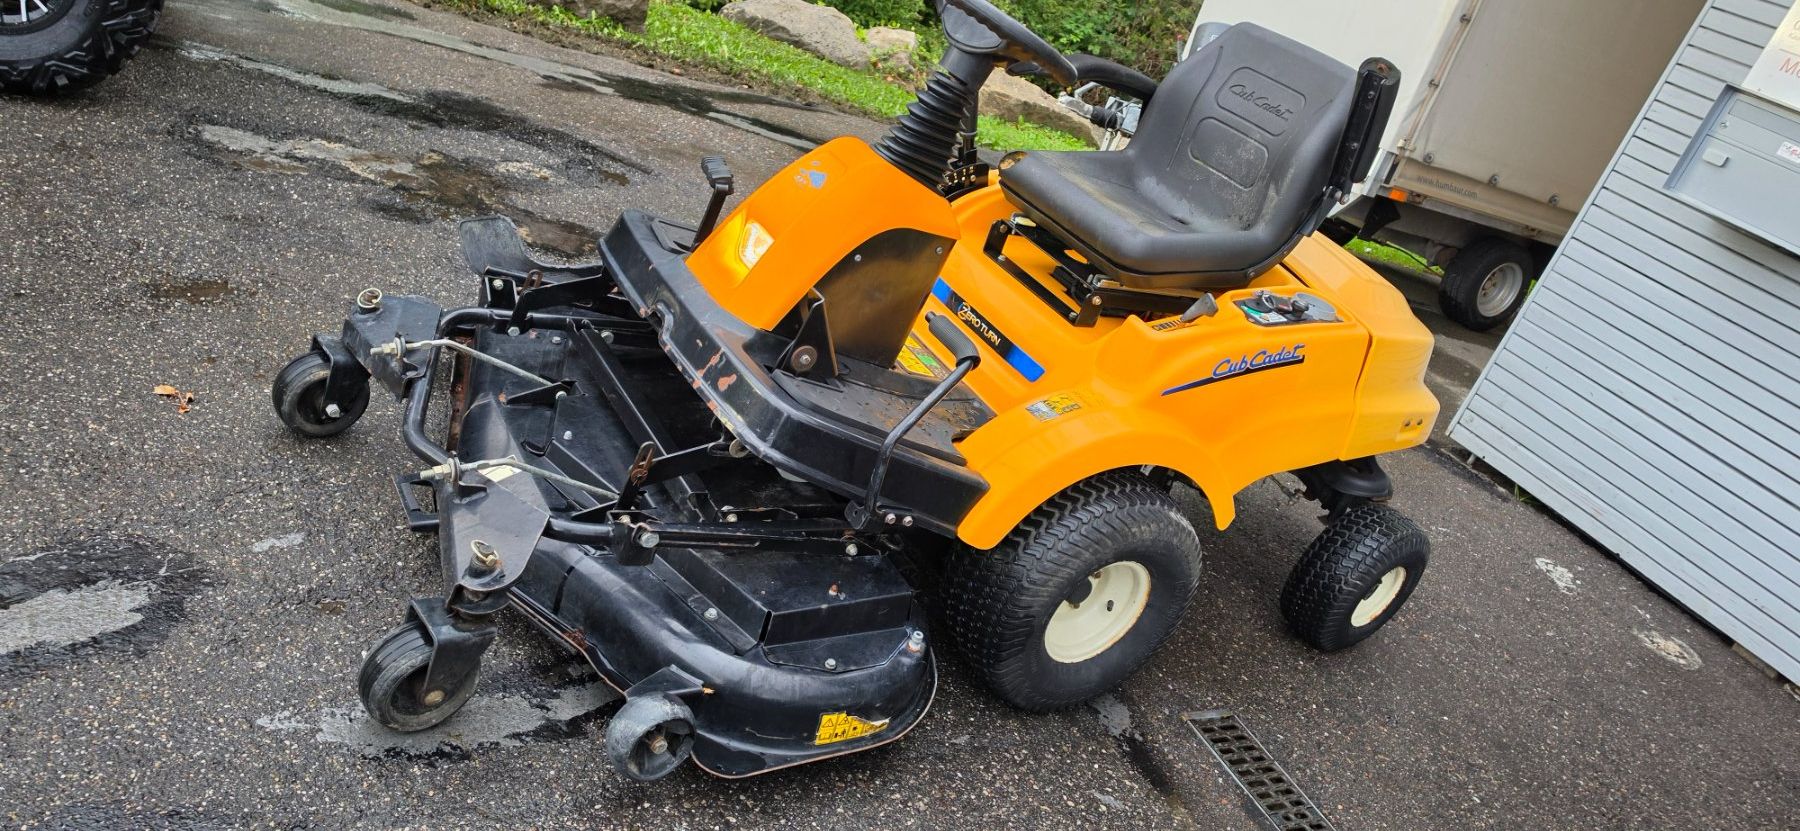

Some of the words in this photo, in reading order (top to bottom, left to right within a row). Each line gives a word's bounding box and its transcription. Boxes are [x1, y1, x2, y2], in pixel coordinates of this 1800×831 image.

[1229, 84, 1255, 102] Cub
[1253, 96, 1294, 121] Cadet
[1417, 175, 1478, 199] www.humbaur.com
[958, 302, 981, 328] ZERO
[980, 322, 1002, 346] TURN
[1212, 355, 1249, 378] Cub
[1249, 343, 1305, 369] Cadet
